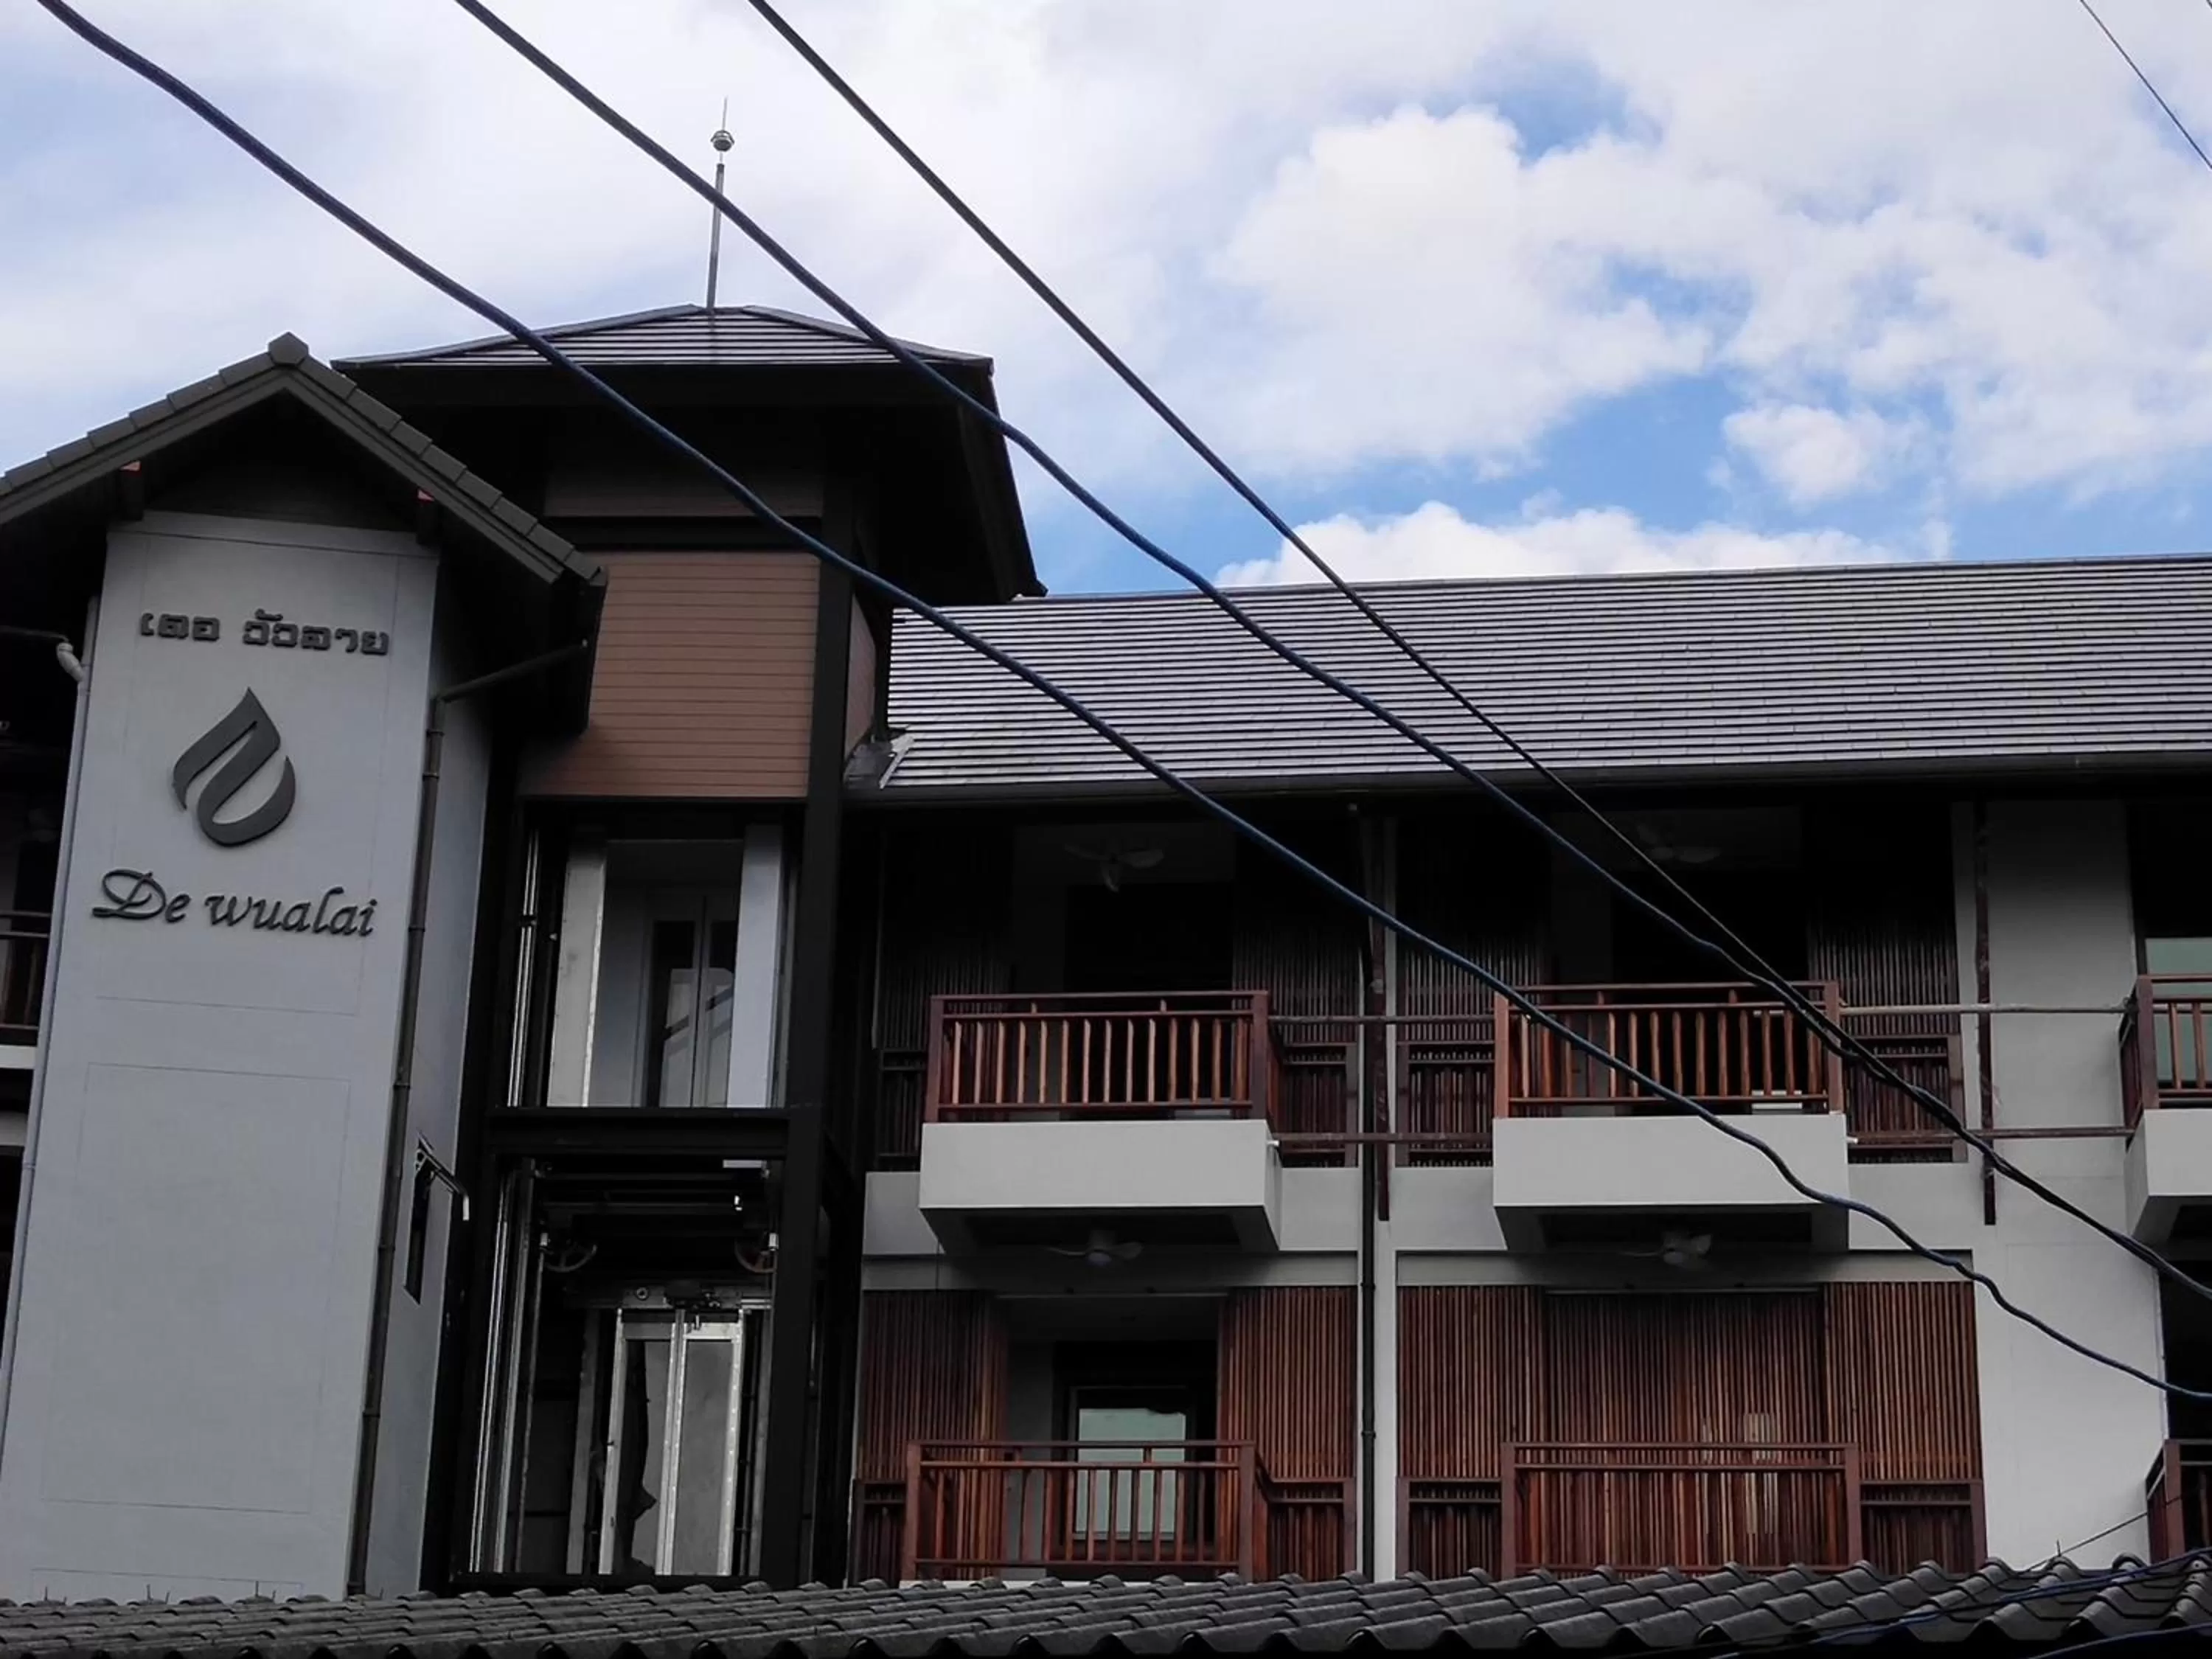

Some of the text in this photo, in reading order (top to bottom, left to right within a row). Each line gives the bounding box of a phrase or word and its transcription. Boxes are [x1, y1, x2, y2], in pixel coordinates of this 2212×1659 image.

[243, 608, 390, 655] วัวลาย
[92, 868, 378, 936] De wualai
